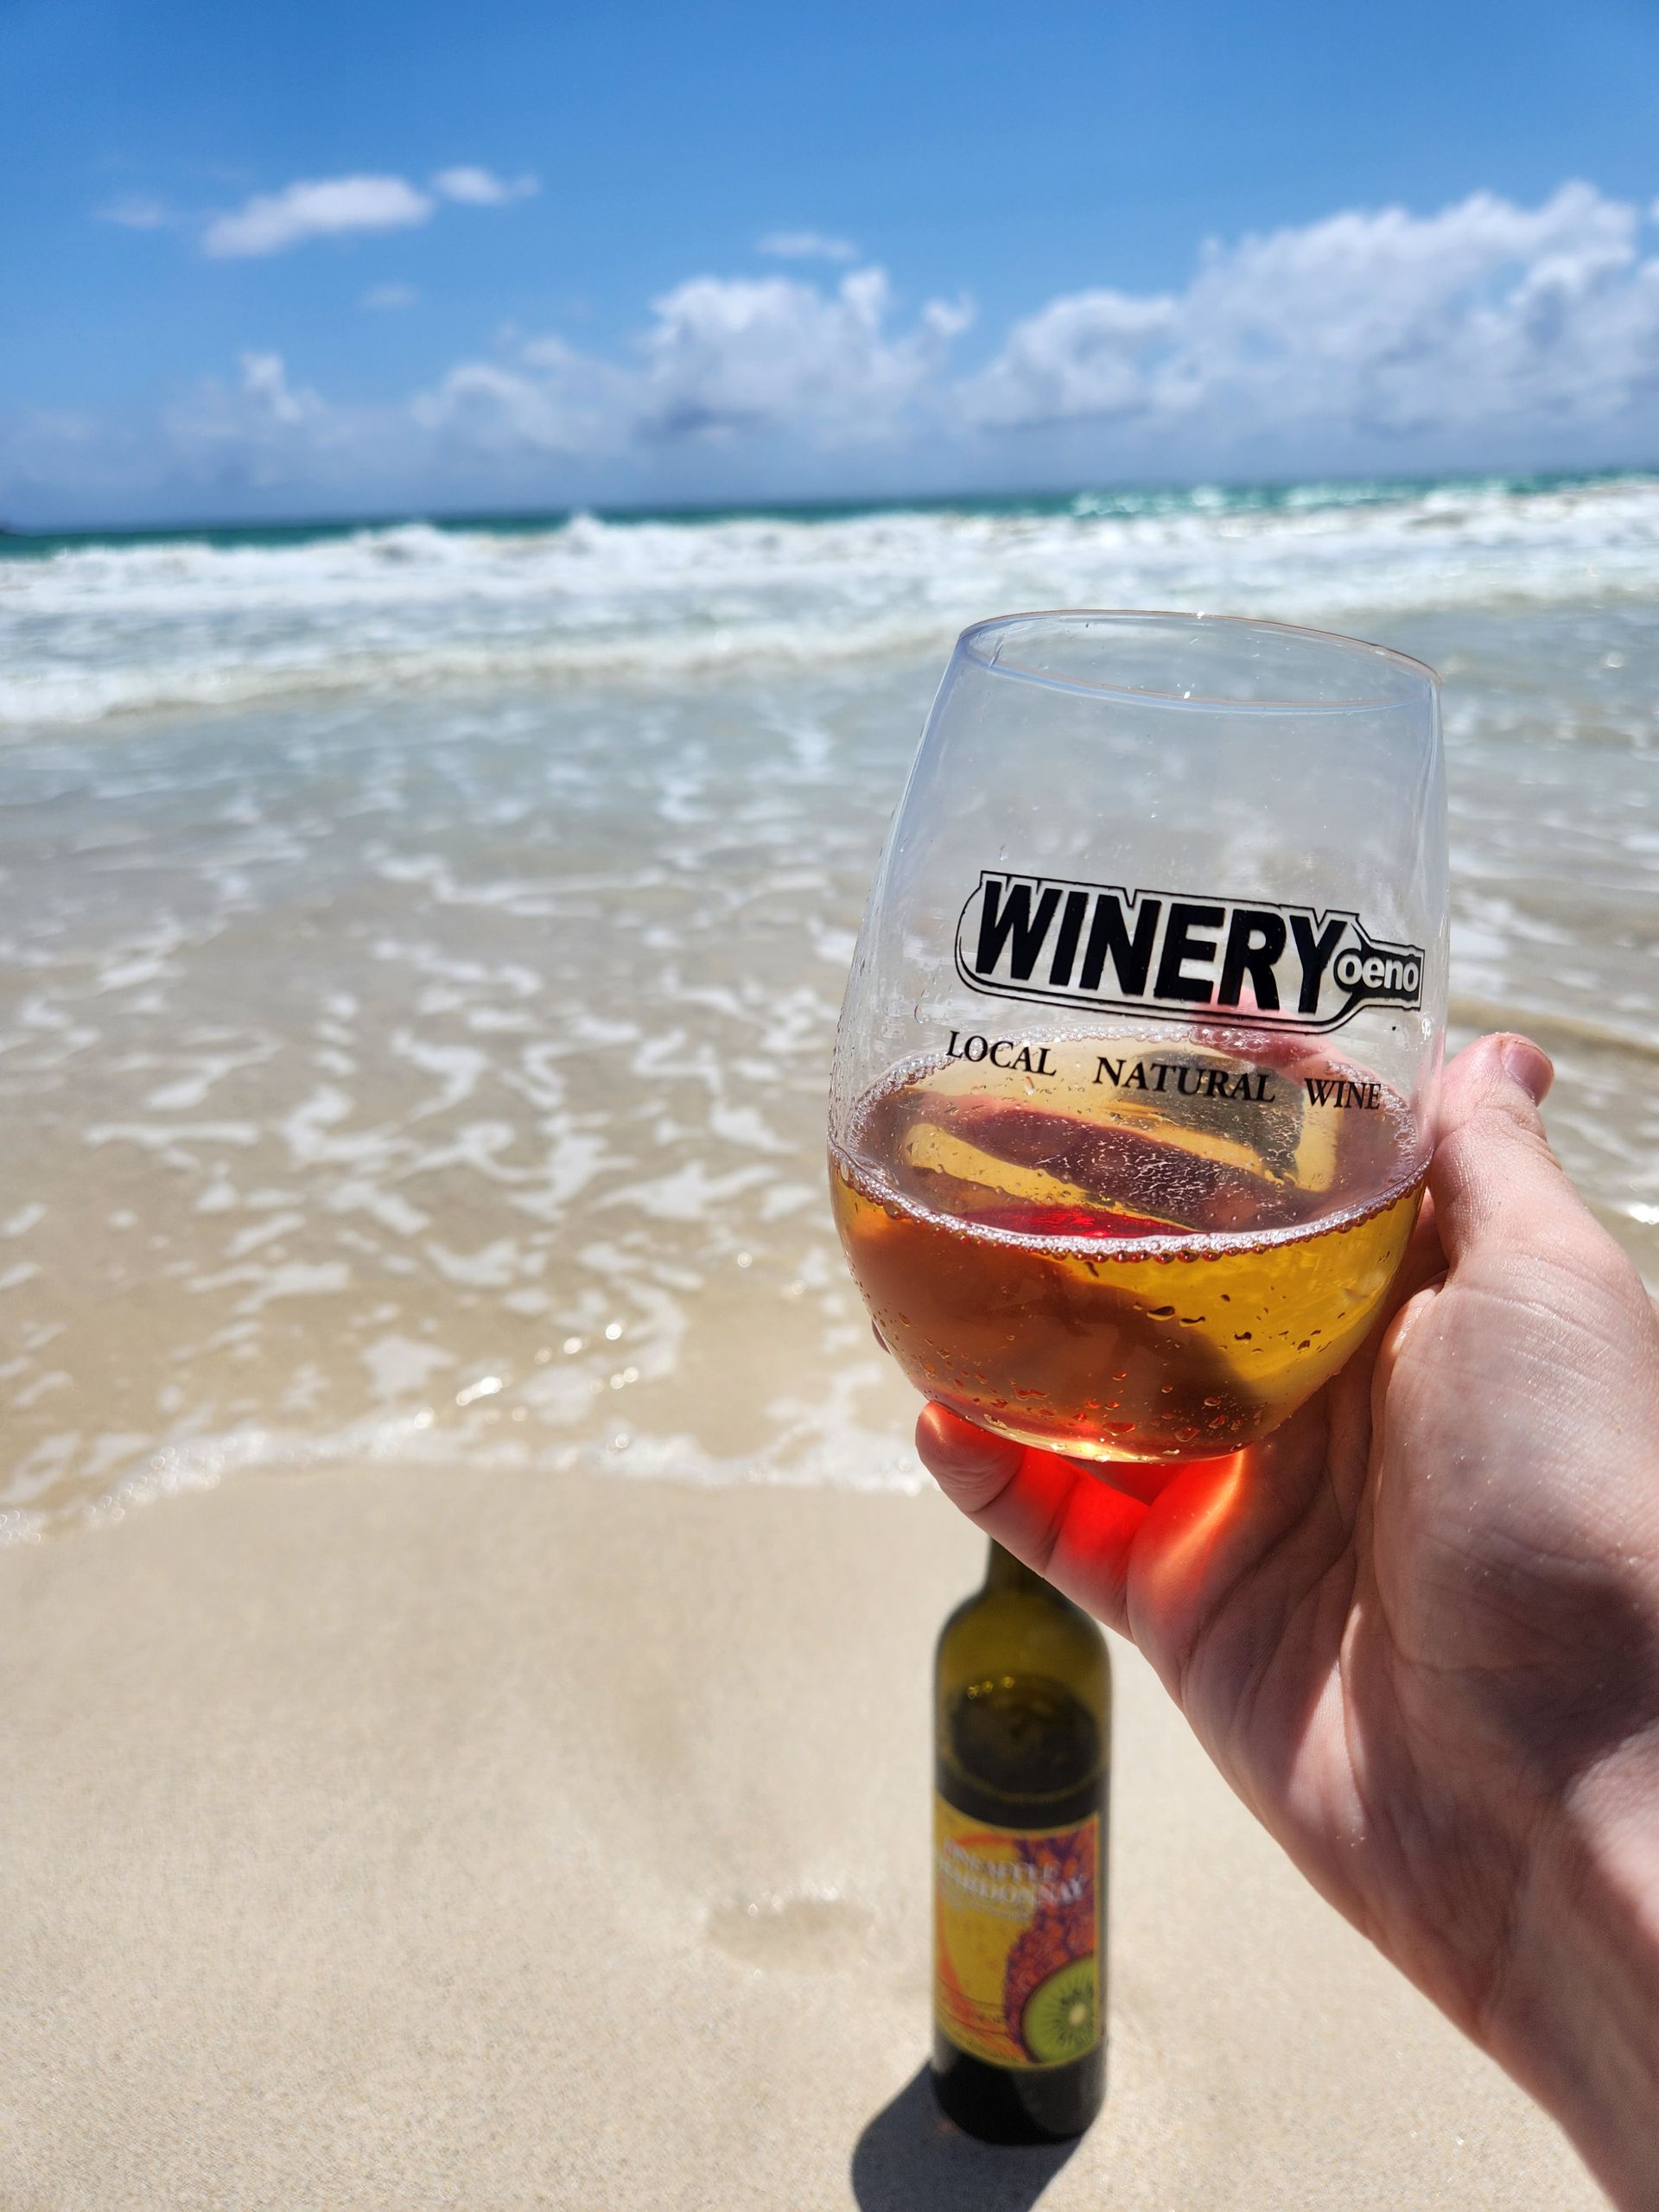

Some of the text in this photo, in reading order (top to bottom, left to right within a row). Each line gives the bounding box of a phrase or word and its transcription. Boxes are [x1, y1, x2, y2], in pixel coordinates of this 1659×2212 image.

[976, 880, 1419, 1014] WINERY oeno
[947, 1031, 1382, 1110] LOCAL NATURAL WINE
